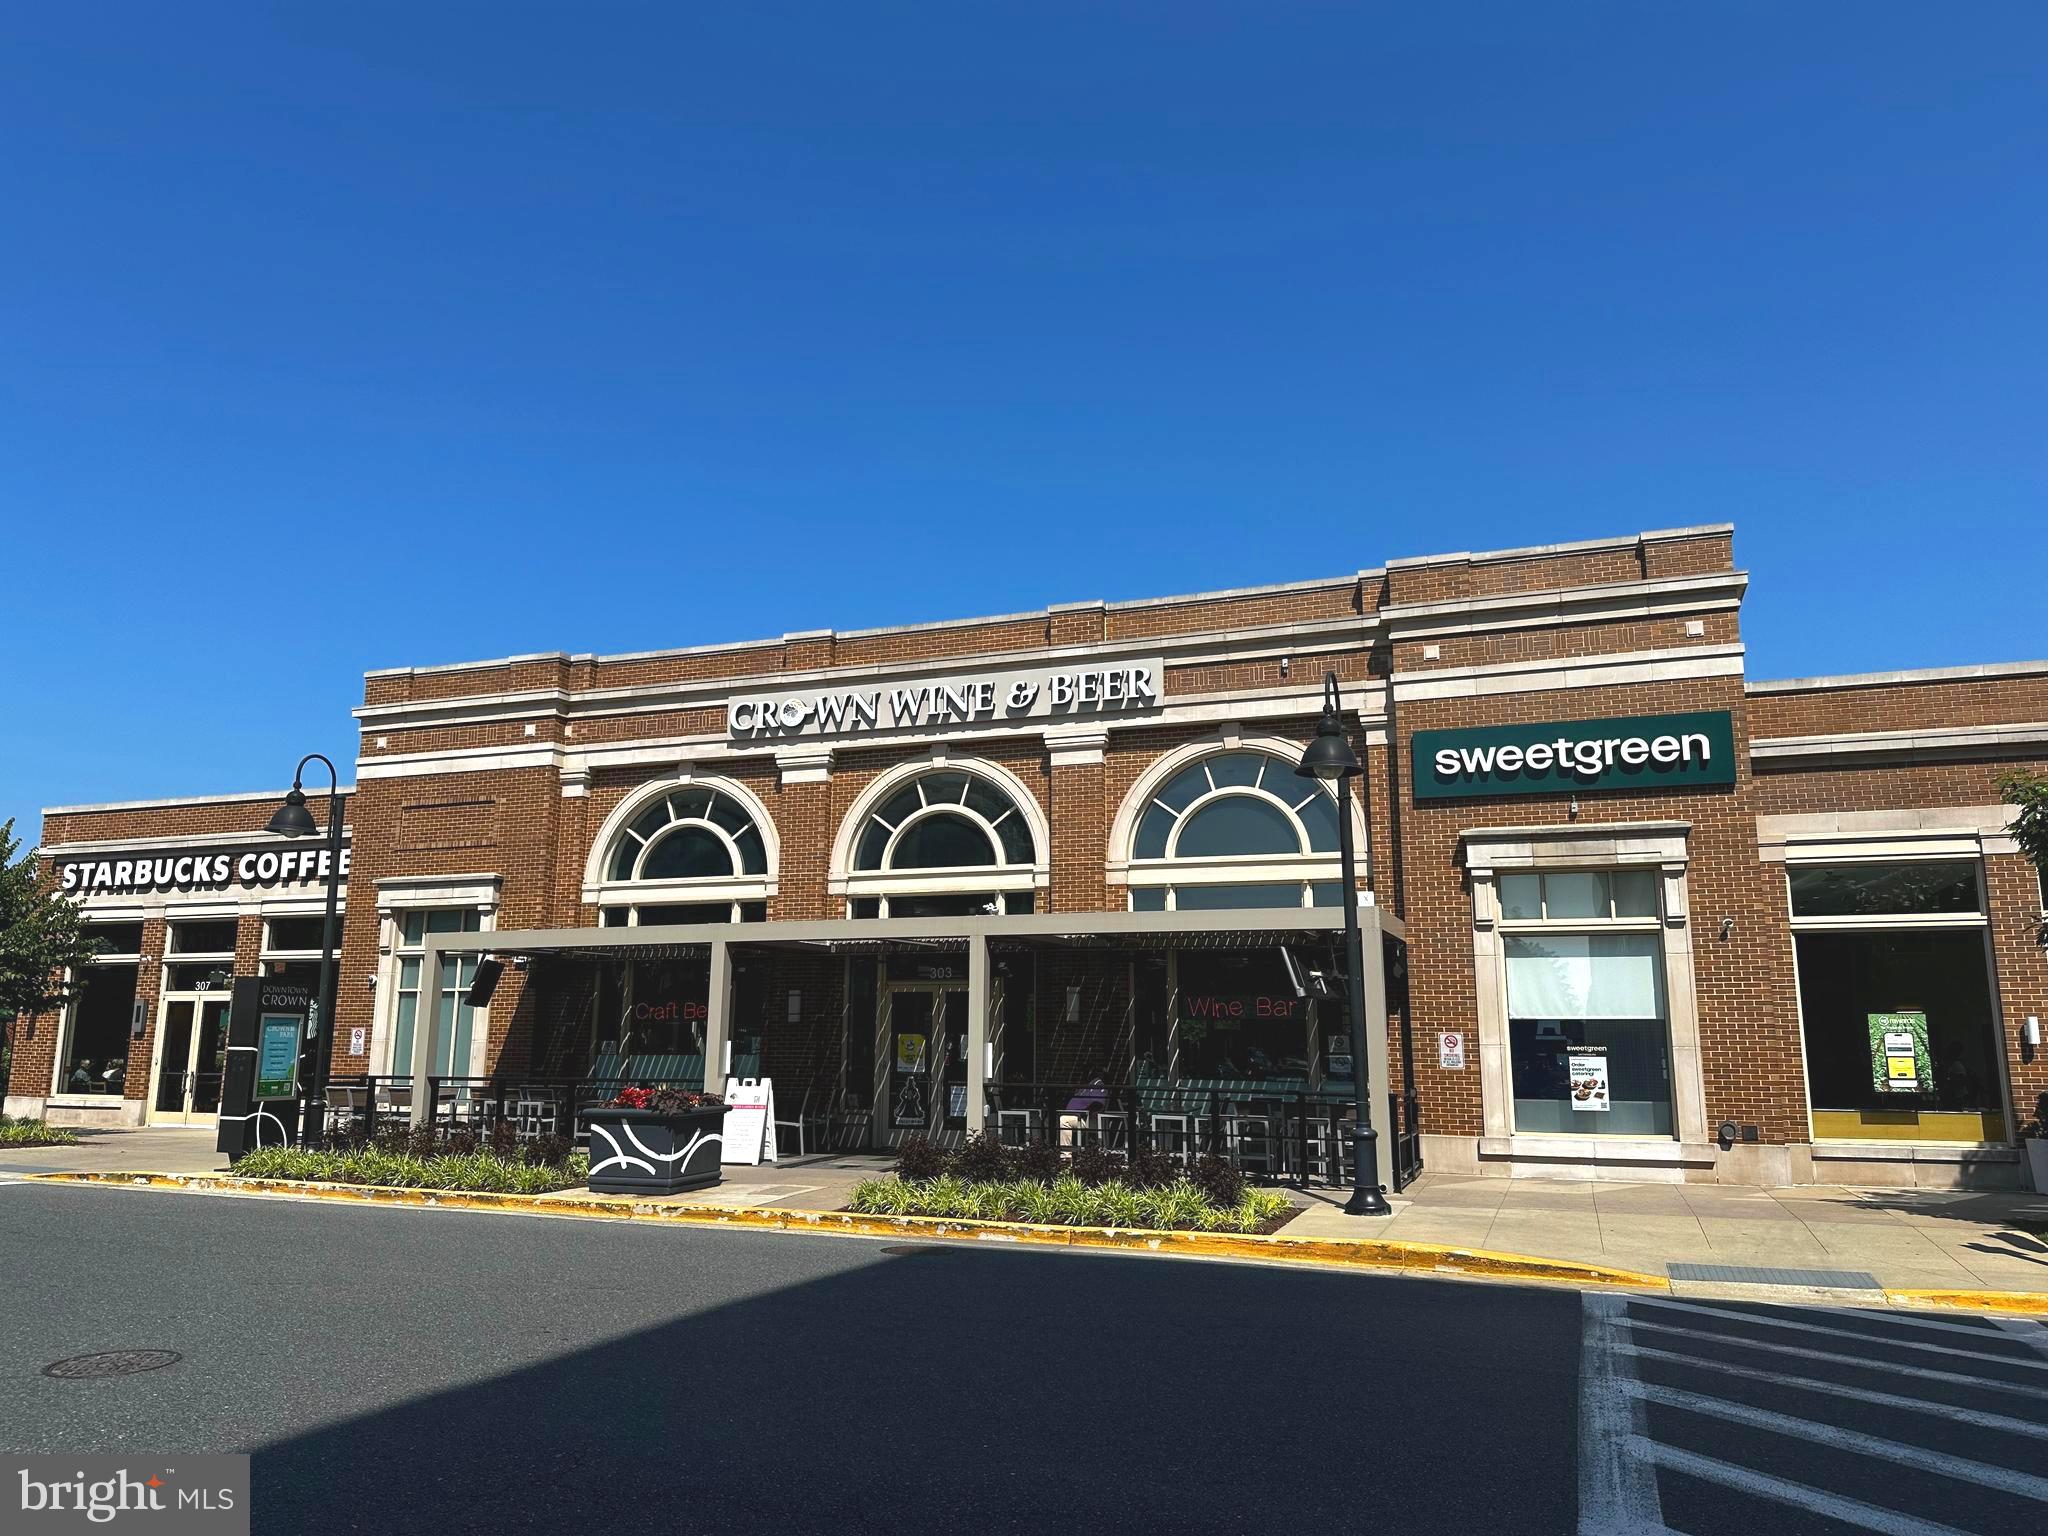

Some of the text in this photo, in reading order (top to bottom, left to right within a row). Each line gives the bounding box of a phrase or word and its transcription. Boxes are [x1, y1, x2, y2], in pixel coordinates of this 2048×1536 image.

[729, 667, 1156, 730] CROWN WINE & BEER
[1435, 733, 1711, 774] sweetgreen
[62, 855, 230, 888] STARBUCKS
[930, 967, 952, 978] 303
[195, 981, 211, 991] 307
[263, 985, 308, 994] DOWNTOWN
[262, 994, 307, 1006] CROWN
[1257, 997, 1297, 1016] Bar
[636, 1002, 708, 1020] Craft Be
